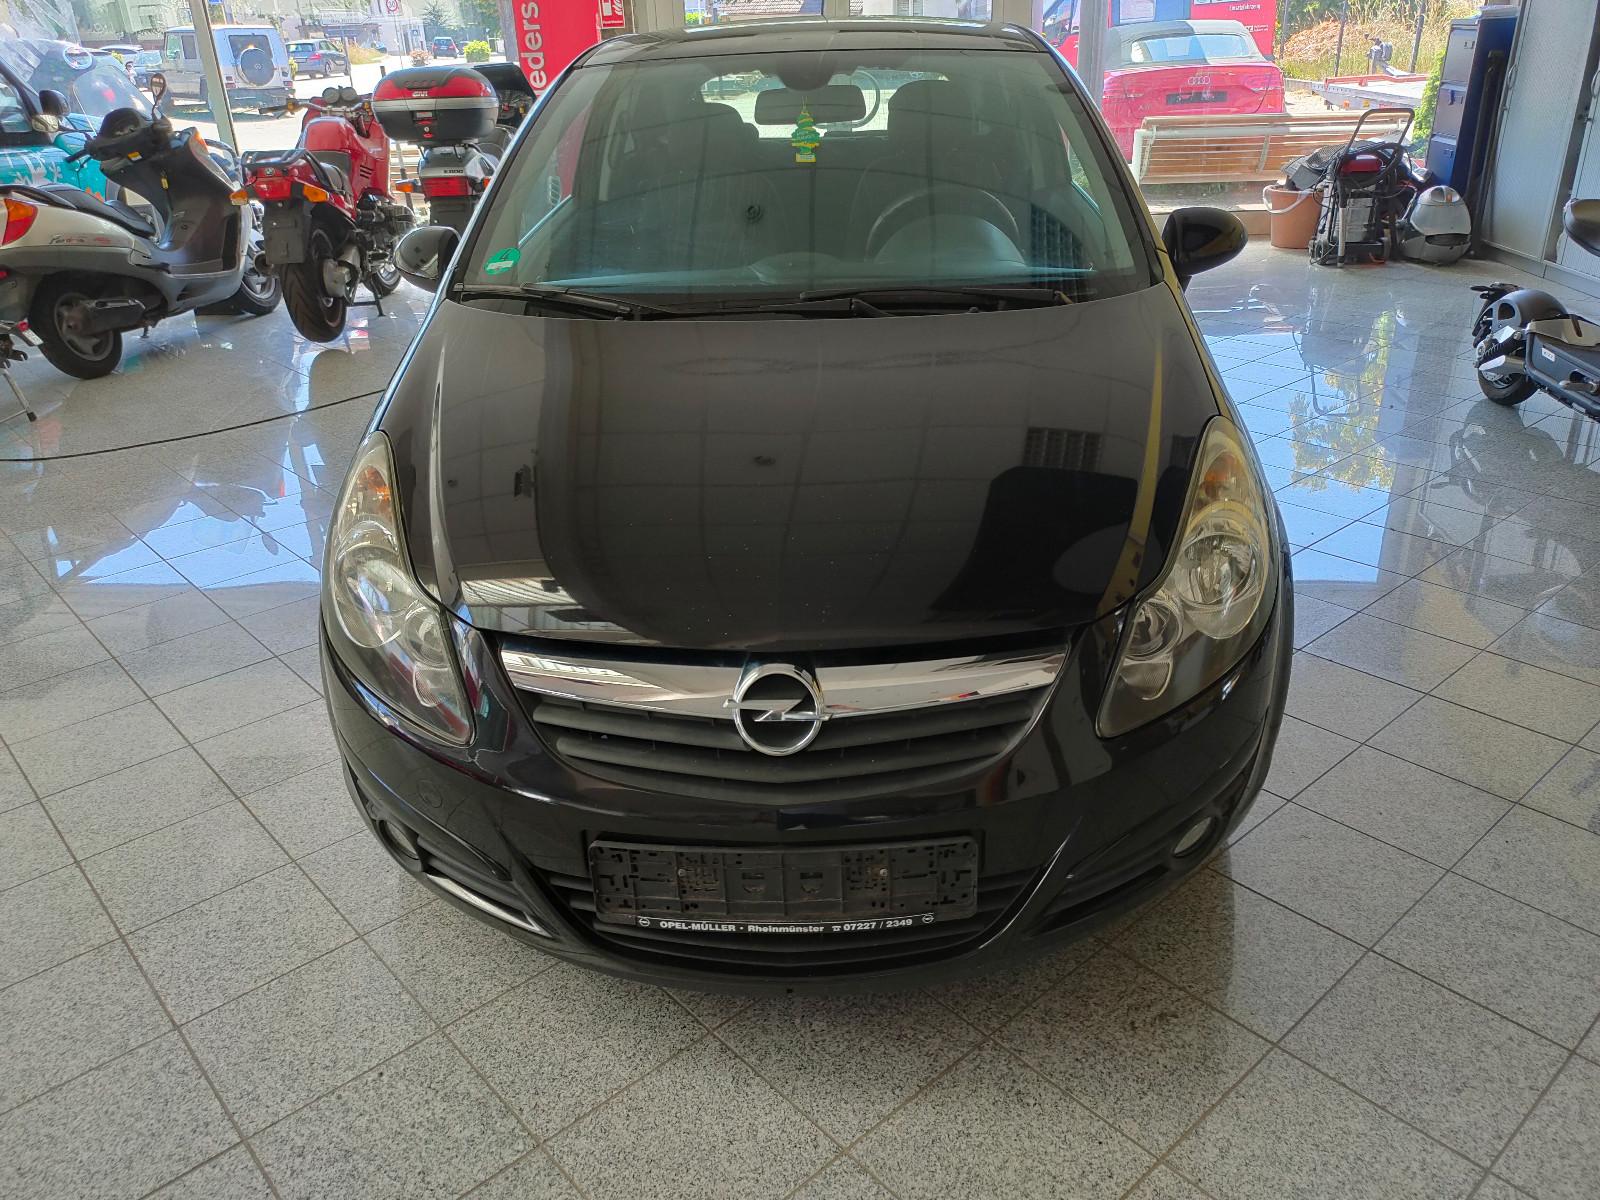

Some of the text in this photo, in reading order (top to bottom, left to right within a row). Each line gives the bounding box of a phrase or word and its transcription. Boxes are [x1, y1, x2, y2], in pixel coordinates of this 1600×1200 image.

[659, 920, 736, 932] OPEL-MÜLLER
[747, 924, 824, 933] Rheinmünster
[843, 922, 876, 931] 07227
[886, 918, 913, 928] 2349
